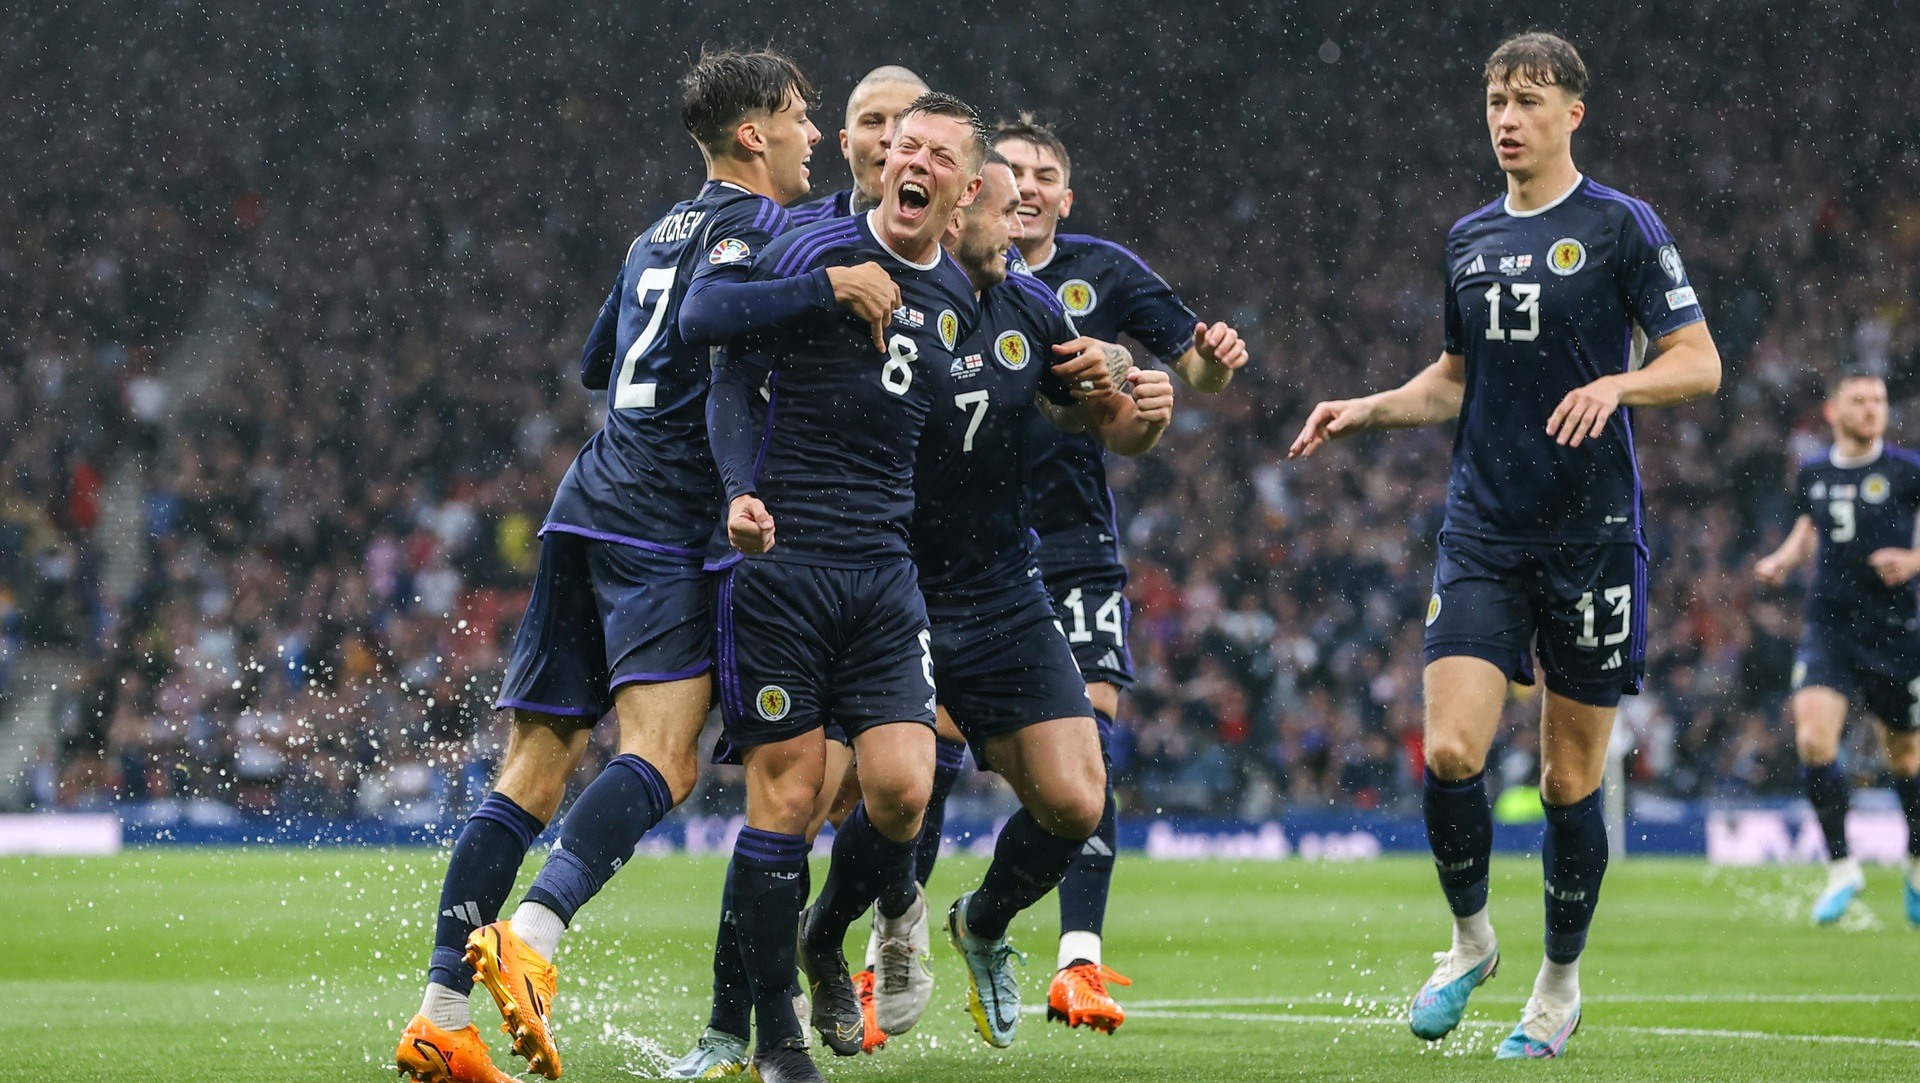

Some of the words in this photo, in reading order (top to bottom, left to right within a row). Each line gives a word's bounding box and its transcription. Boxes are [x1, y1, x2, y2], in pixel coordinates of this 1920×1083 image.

[614, 267, 677, 409] 2
[1484, 282, 1541, 342] 13
[881, 333, 919, 396] 8
[954, 389, 989, 452] 7
[1829, 500, 1856, 543] 9
[1063, 588, 1124, 647] 14
[1575, 584, 1631, 648] 13
